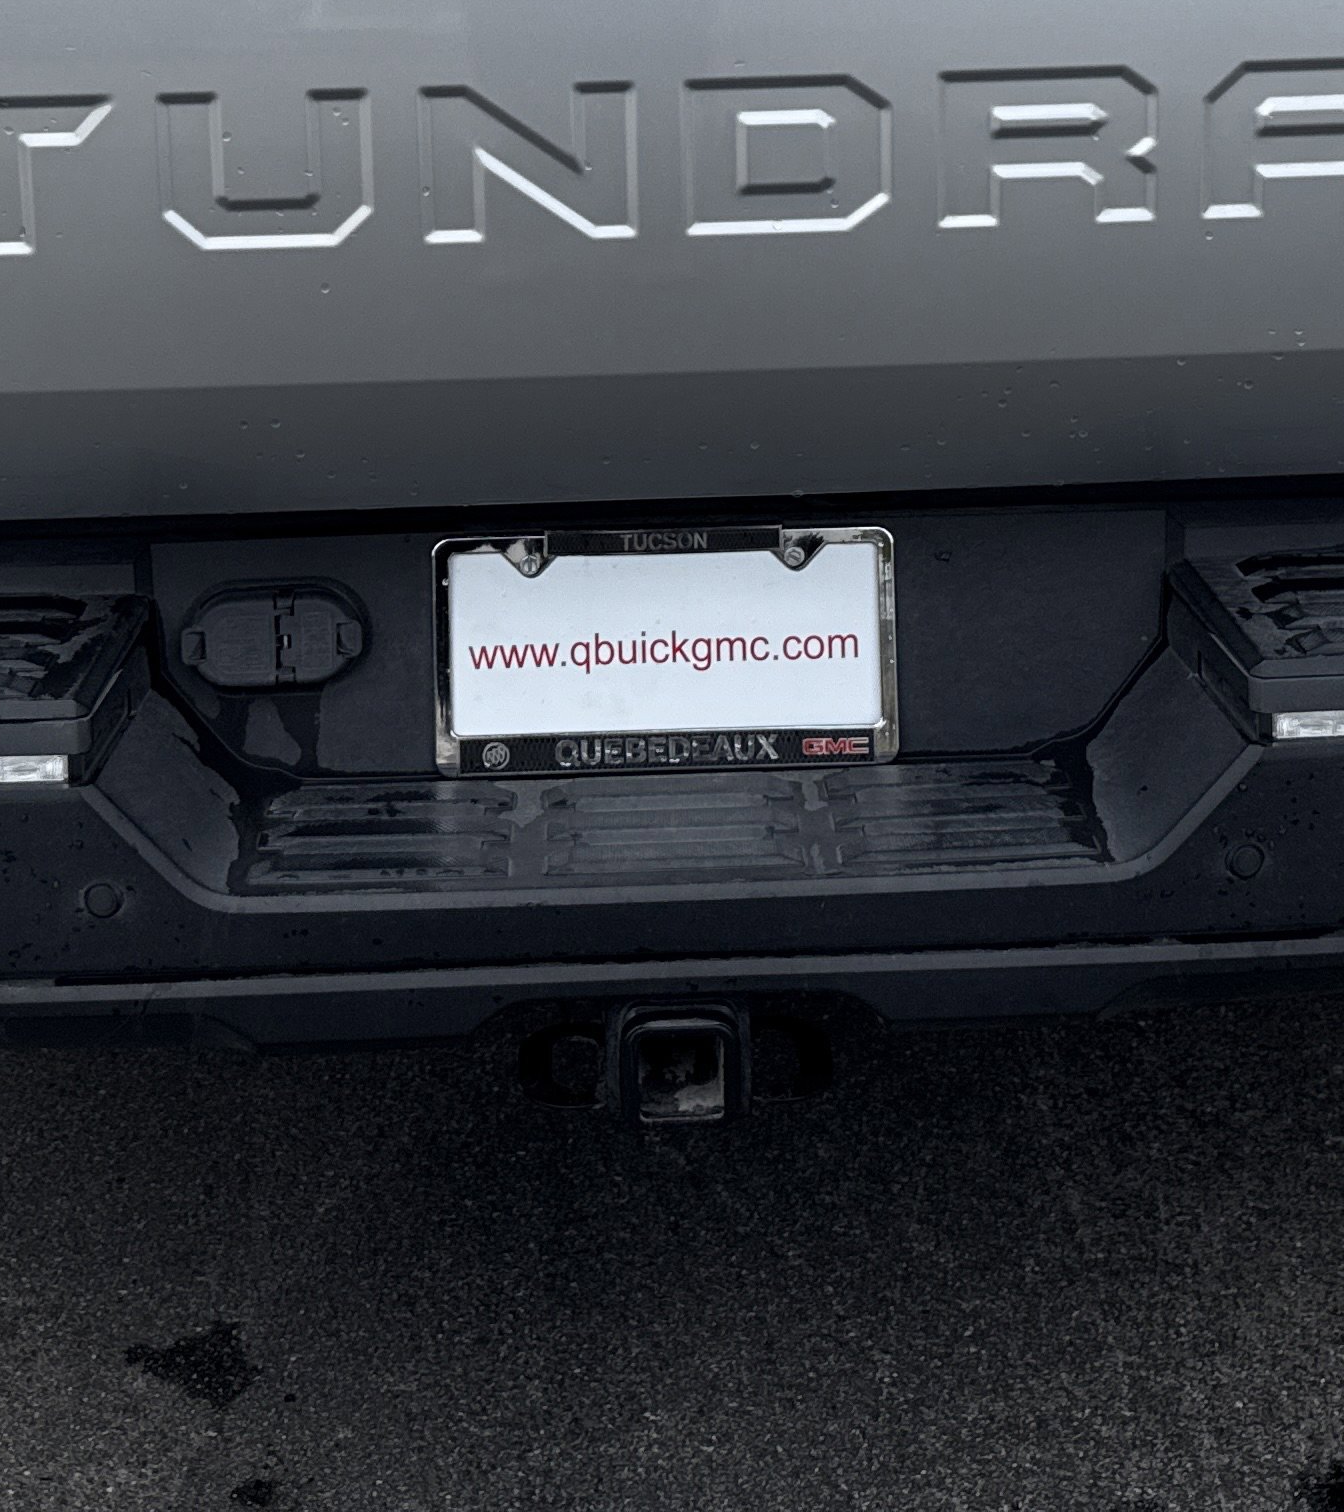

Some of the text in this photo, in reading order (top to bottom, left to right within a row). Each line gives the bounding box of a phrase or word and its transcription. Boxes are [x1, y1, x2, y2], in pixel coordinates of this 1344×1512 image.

[619, 531, 708, 552] TUCSON
[467, 630, 860, 675] www.qbuickgmc.com
[555, 733, 870, 769] QUEBEDEAUX GMC
